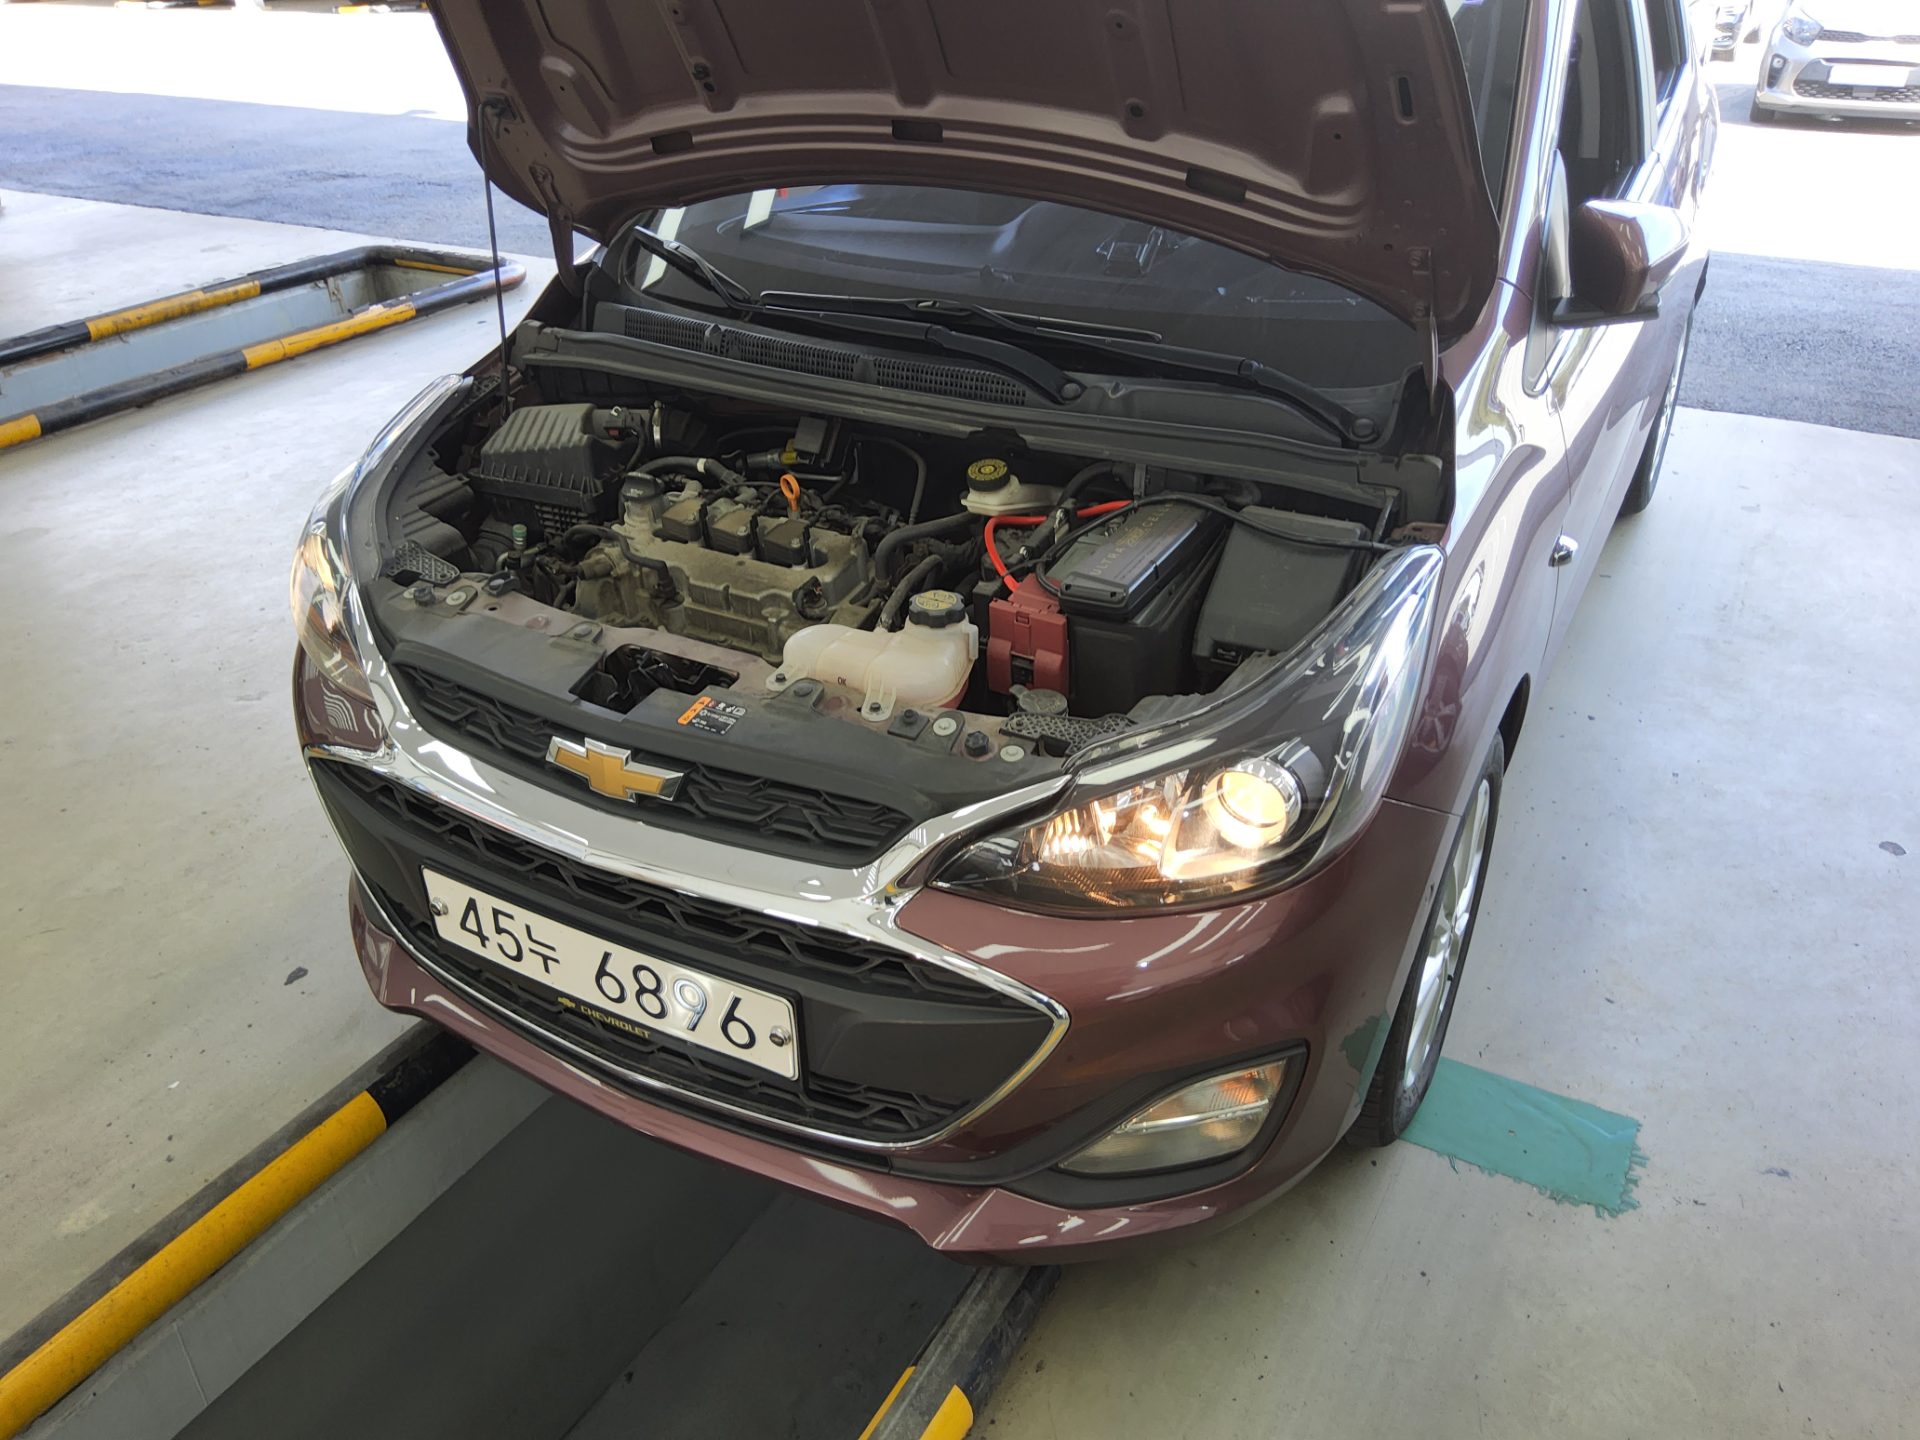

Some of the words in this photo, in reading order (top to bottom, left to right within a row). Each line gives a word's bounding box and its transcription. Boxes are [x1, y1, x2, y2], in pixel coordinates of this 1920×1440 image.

[1090, 546, 1126, 577] ULTRA
[460, 897, 560, 975] 45누
[594, 951, 757, 1050] 6896
[580, 1005, 650, 1038] CHEVROLET
